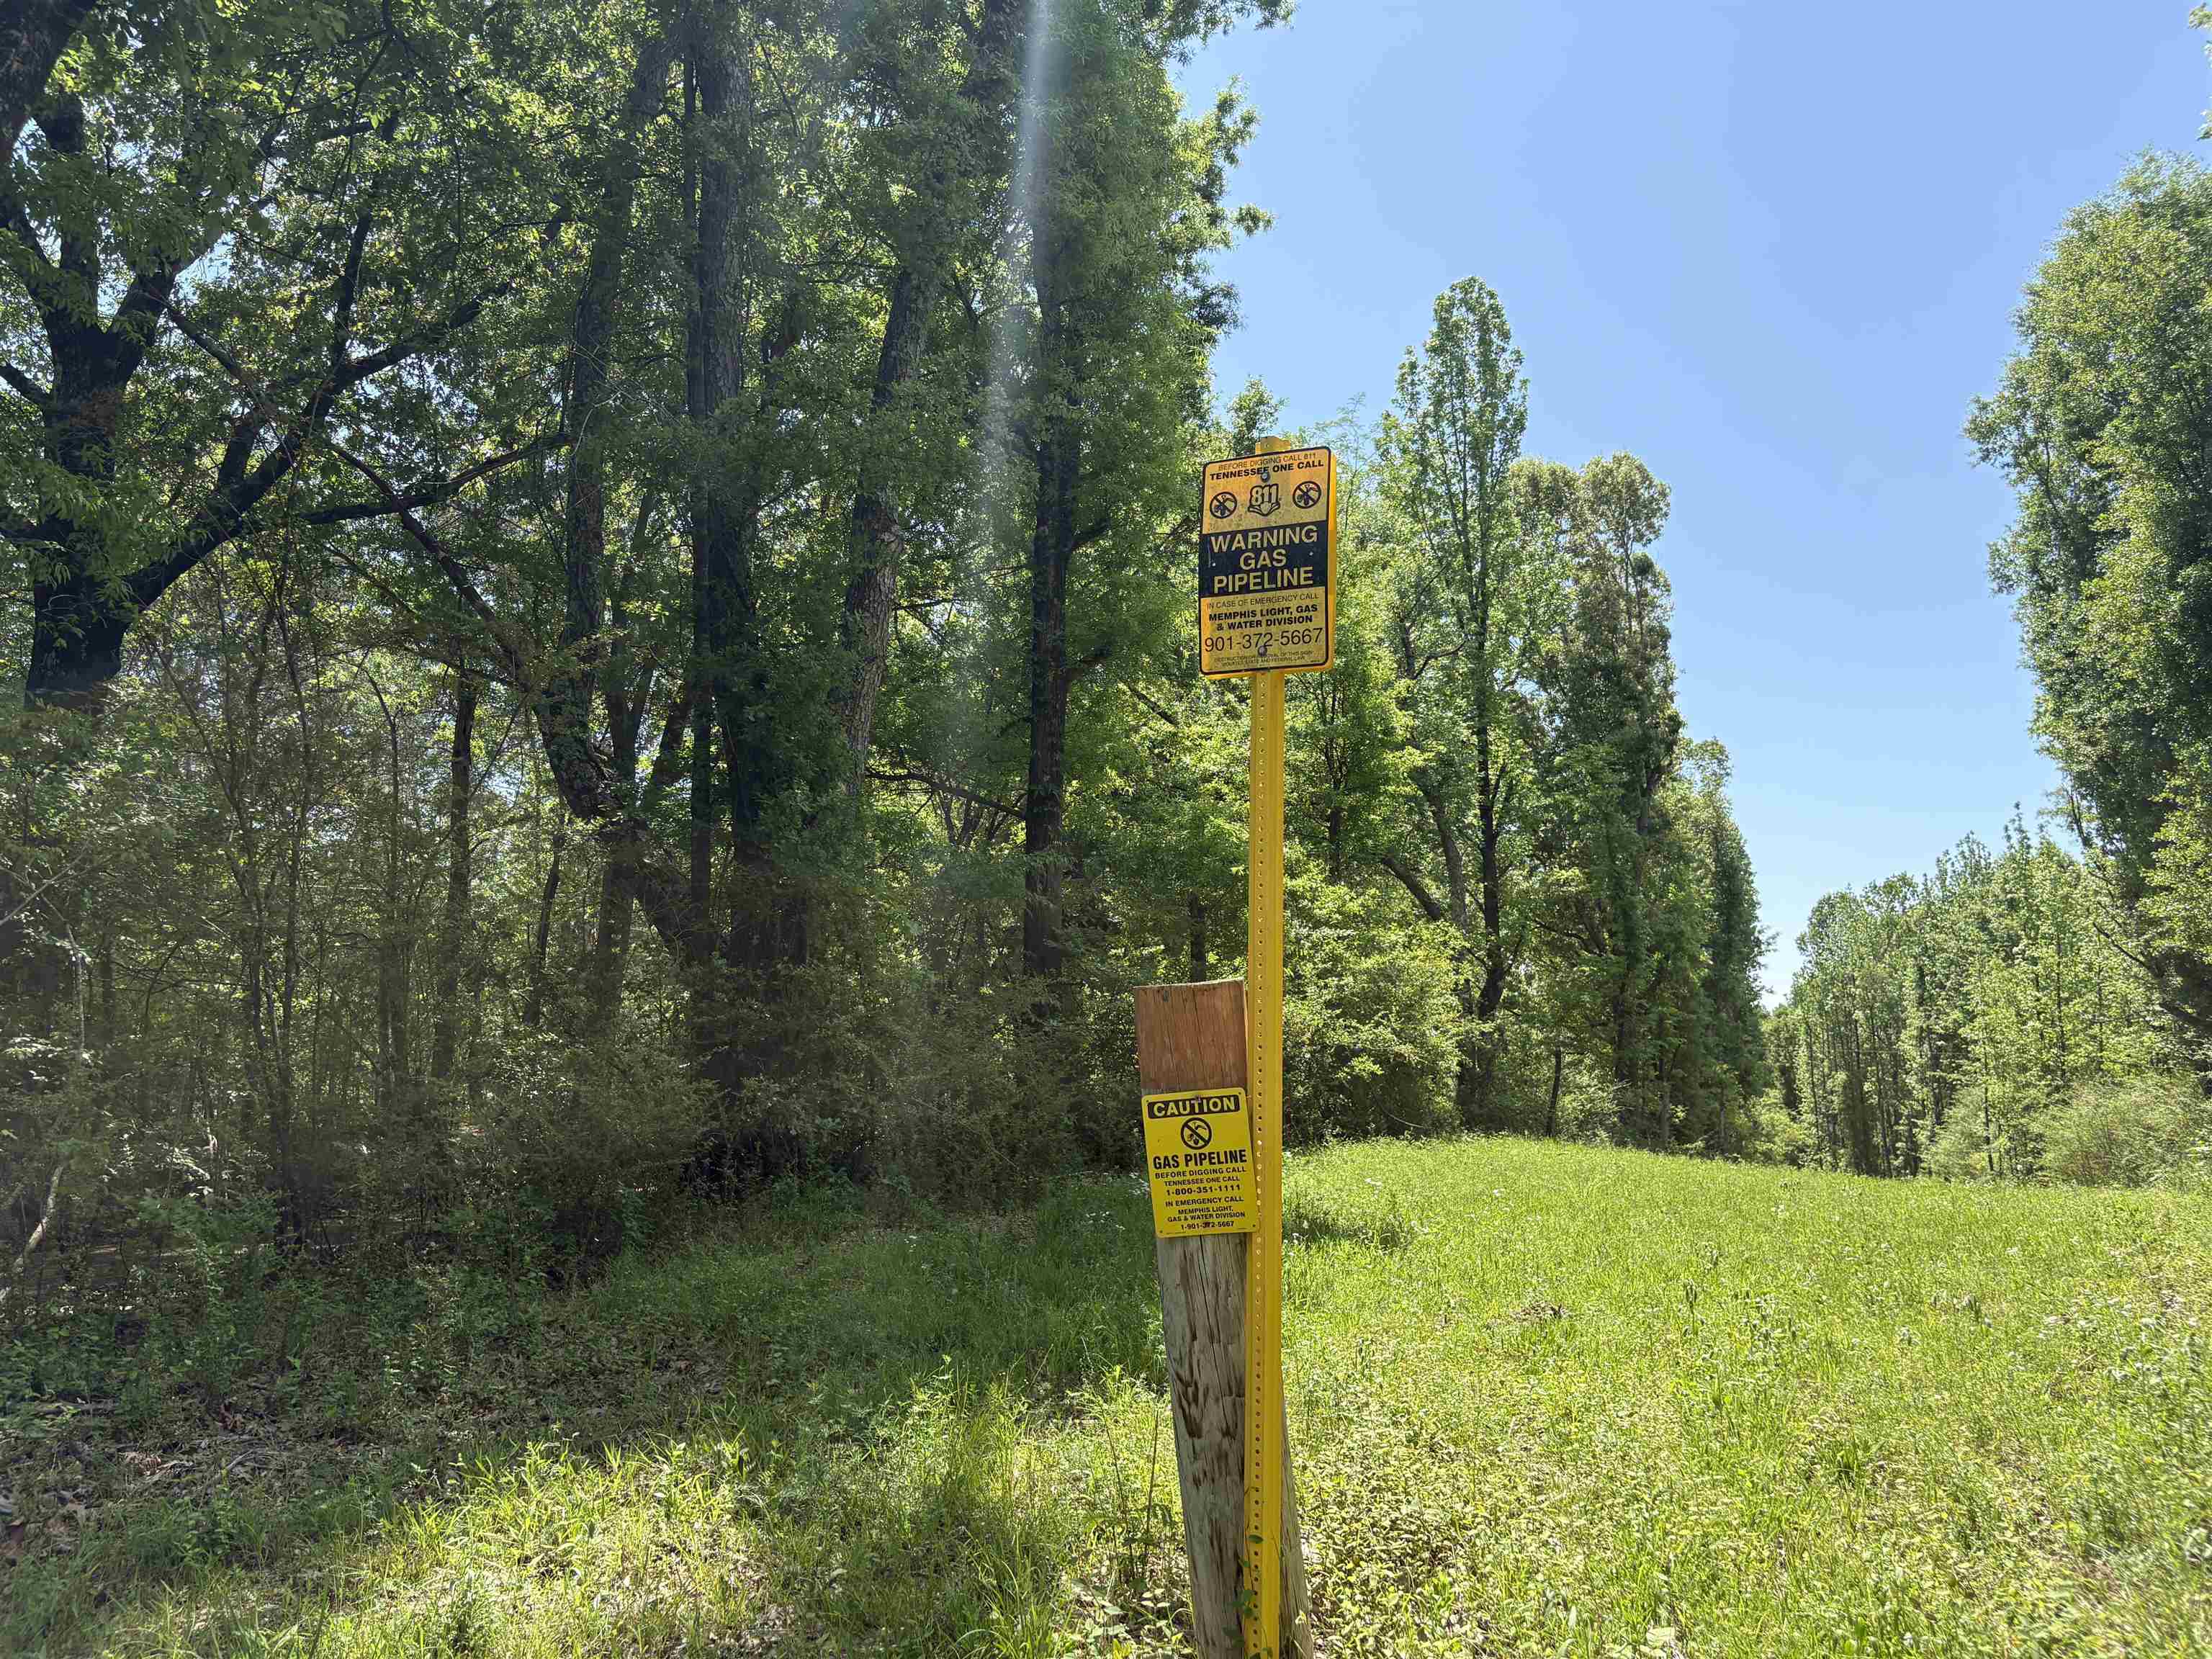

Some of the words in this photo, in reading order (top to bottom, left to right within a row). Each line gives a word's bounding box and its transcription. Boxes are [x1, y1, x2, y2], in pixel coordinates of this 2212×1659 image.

[1210, 467, 1269, 480] TENNESSEE
[1272, 463, 1295, 472] ONE
[1298, 460, 1324, 469] CALL
[1218, 462, 1247, 471] BEFORE
[1250, 457, 1282, 467] DIGGING
[1283, 454, 1302, 463] CALL
[1251, 485, 1279, 505] 811
[1210, 525, 1318, 553] WARNING
[1240, 549, 1287, 570] GAS
[1214, 566, 1313, 594] PIPELINE
[1216, 599, 1236, 608] CASE
[1238, 598, 1248, 607] OF
[1250, 595, 1298, 606] EMERGENCY
[1209, 610, 1256, 622] MEMPHIS
[1260, 606, 1293, 617] LIGHT,
[1296, 604, 1318, 613] GAS
[1228, 619, 1262, 630] WATER
[1266, 615, 1313, 626] DIVISION
[1205, 627, 1323, 652] 901-372-5667
[1154, 1097, 1235, 1117] CAUTION
[1153, 1154, 1179, 1170] GAS
[1184, 1149, 1247, 1167] PIPELINE
[1189, 1168, 1224, 1177] DIGGING
[1166, 1184, 1241, 1196] 1-800-351-1111
[1175, 1197, 1222, 1207] EMERGENCY
